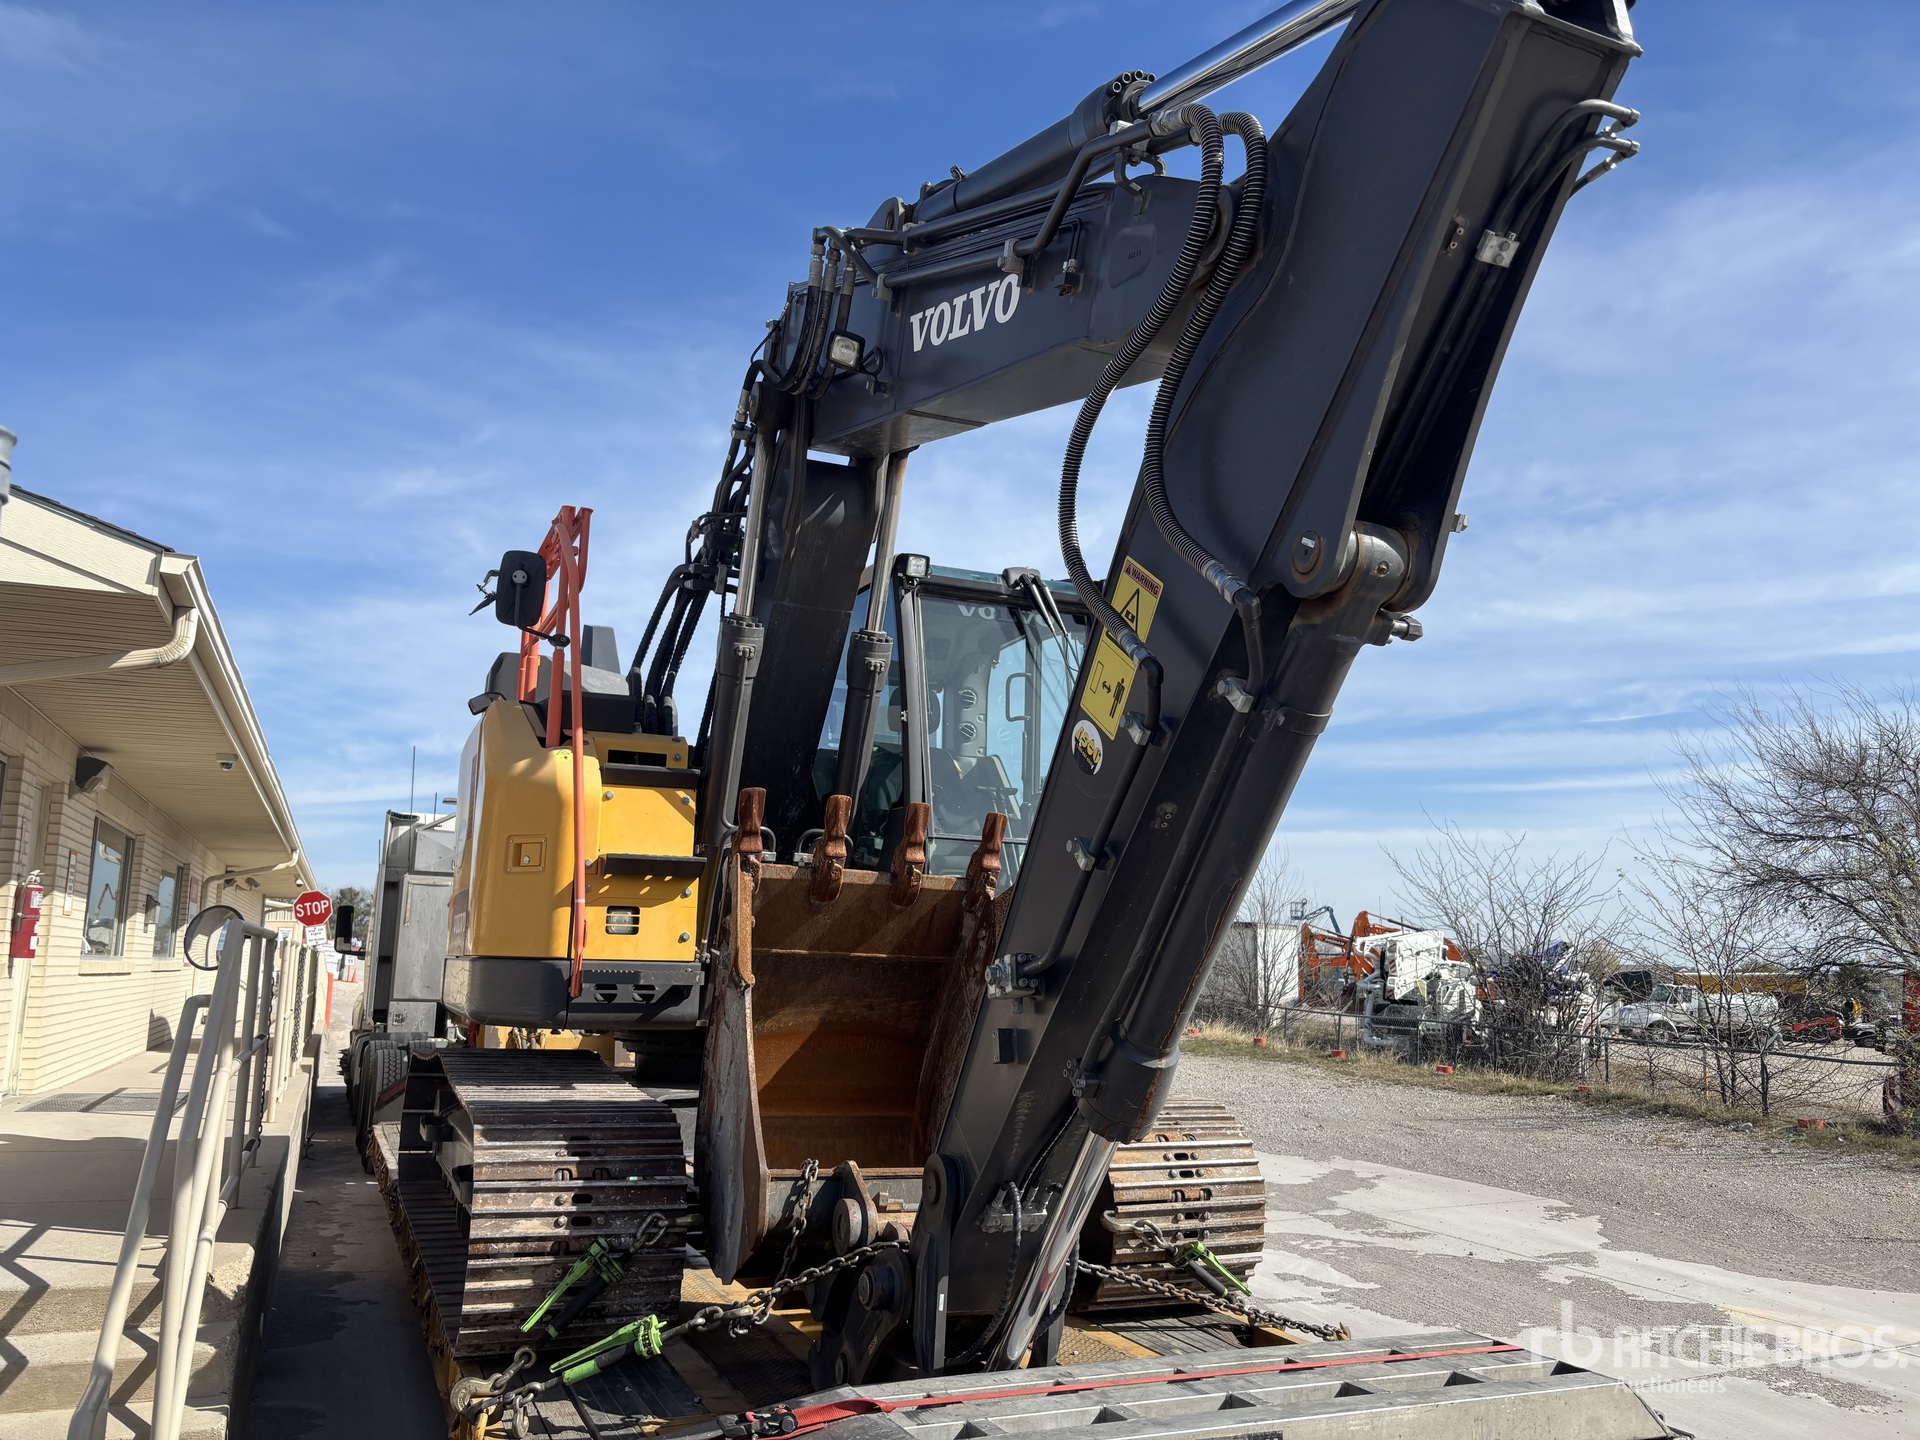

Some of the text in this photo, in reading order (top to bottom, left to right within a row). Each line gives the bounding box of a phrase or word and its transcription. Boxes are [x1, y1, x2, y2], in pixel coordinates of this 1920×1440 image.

[910, 273, 1021, 353] VOLVO
[1130, 567, 1160, 596] WARNING
[295, 899, 329, 918] STOP
